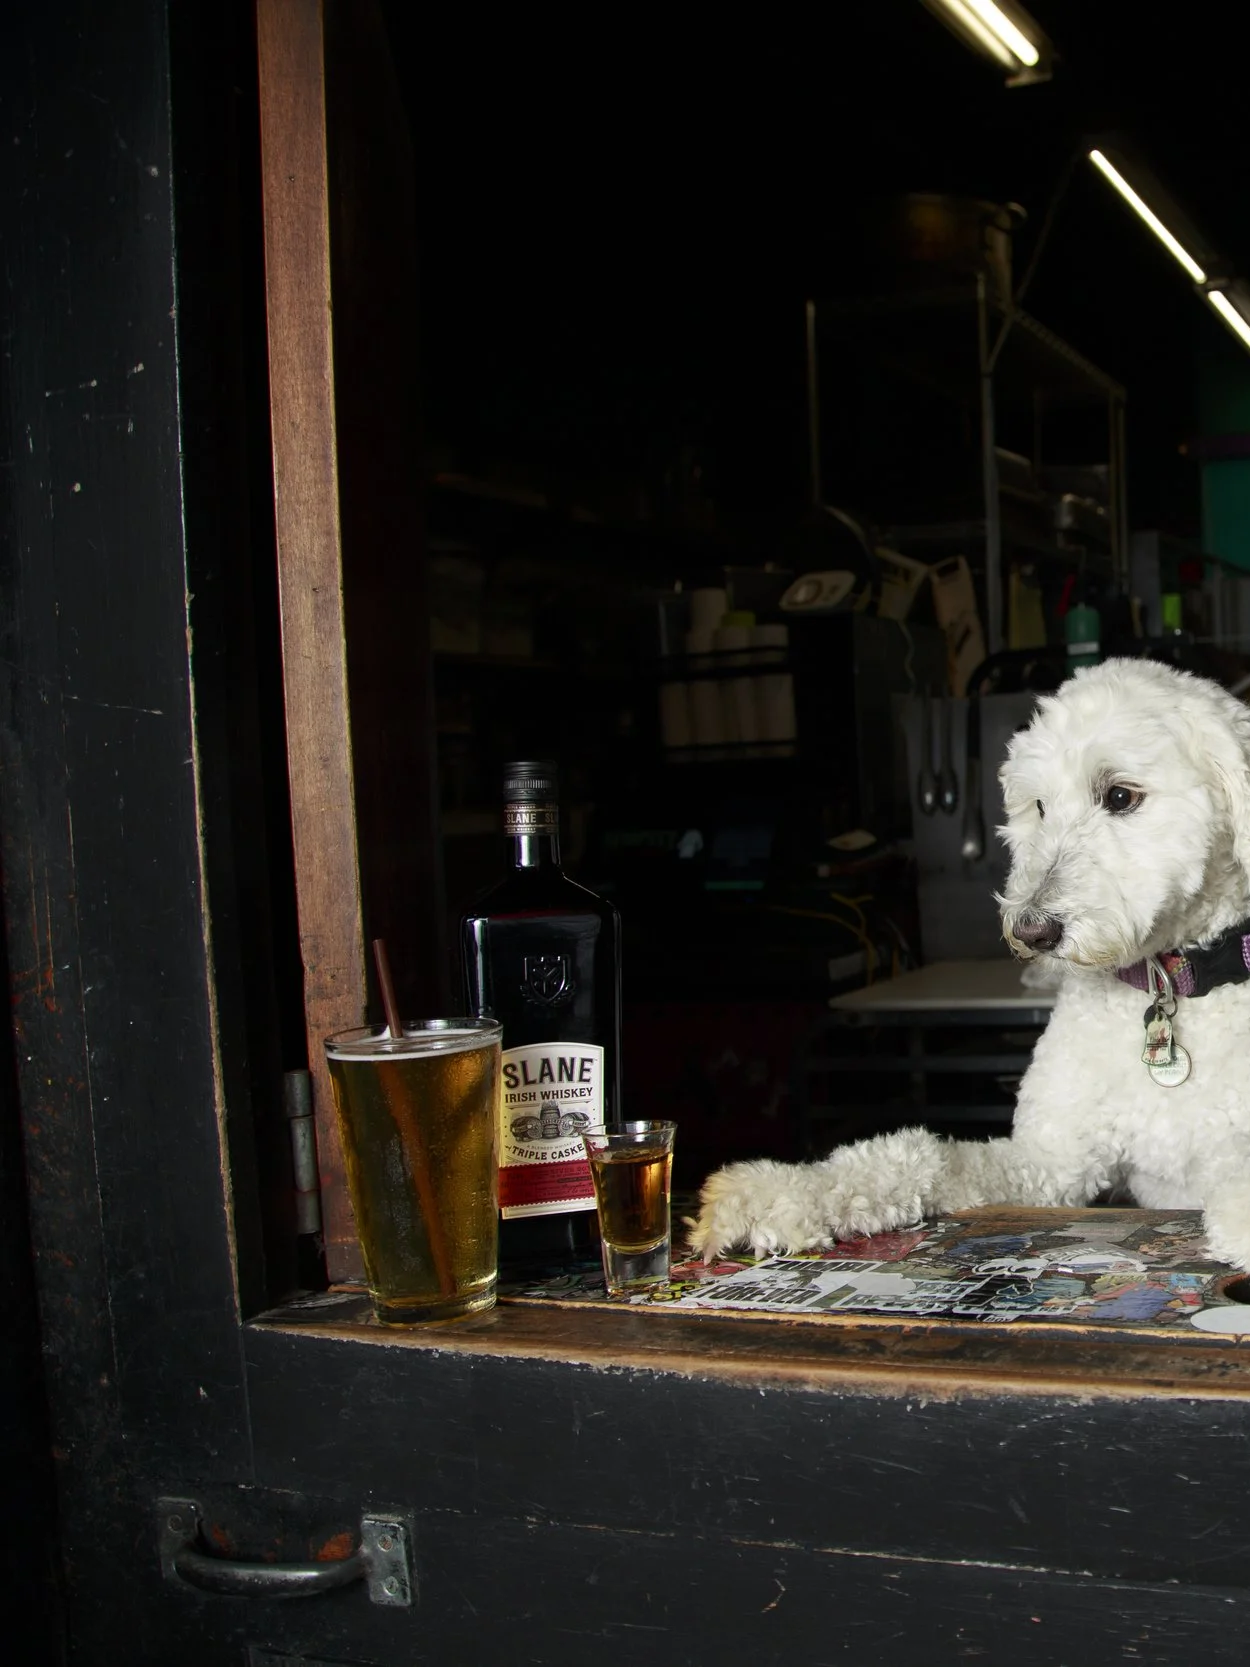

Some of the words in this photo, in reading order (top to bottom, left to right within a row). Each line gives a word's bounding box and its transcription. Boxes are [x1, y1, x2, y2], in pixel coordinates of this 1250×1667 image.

[506, 812, 537, 824] SLANE
[503, 1057, 594, 1089] SLANE
[505, 1091, 537, 1103] IRISH
[540, 1087, 593, 1100] WHISKEY
[512, 1146, 547, 1160] TRIPLE
[551, 1143, 585, 1159] CASKE
[696, 1284, 823, 1305] FOREVER
